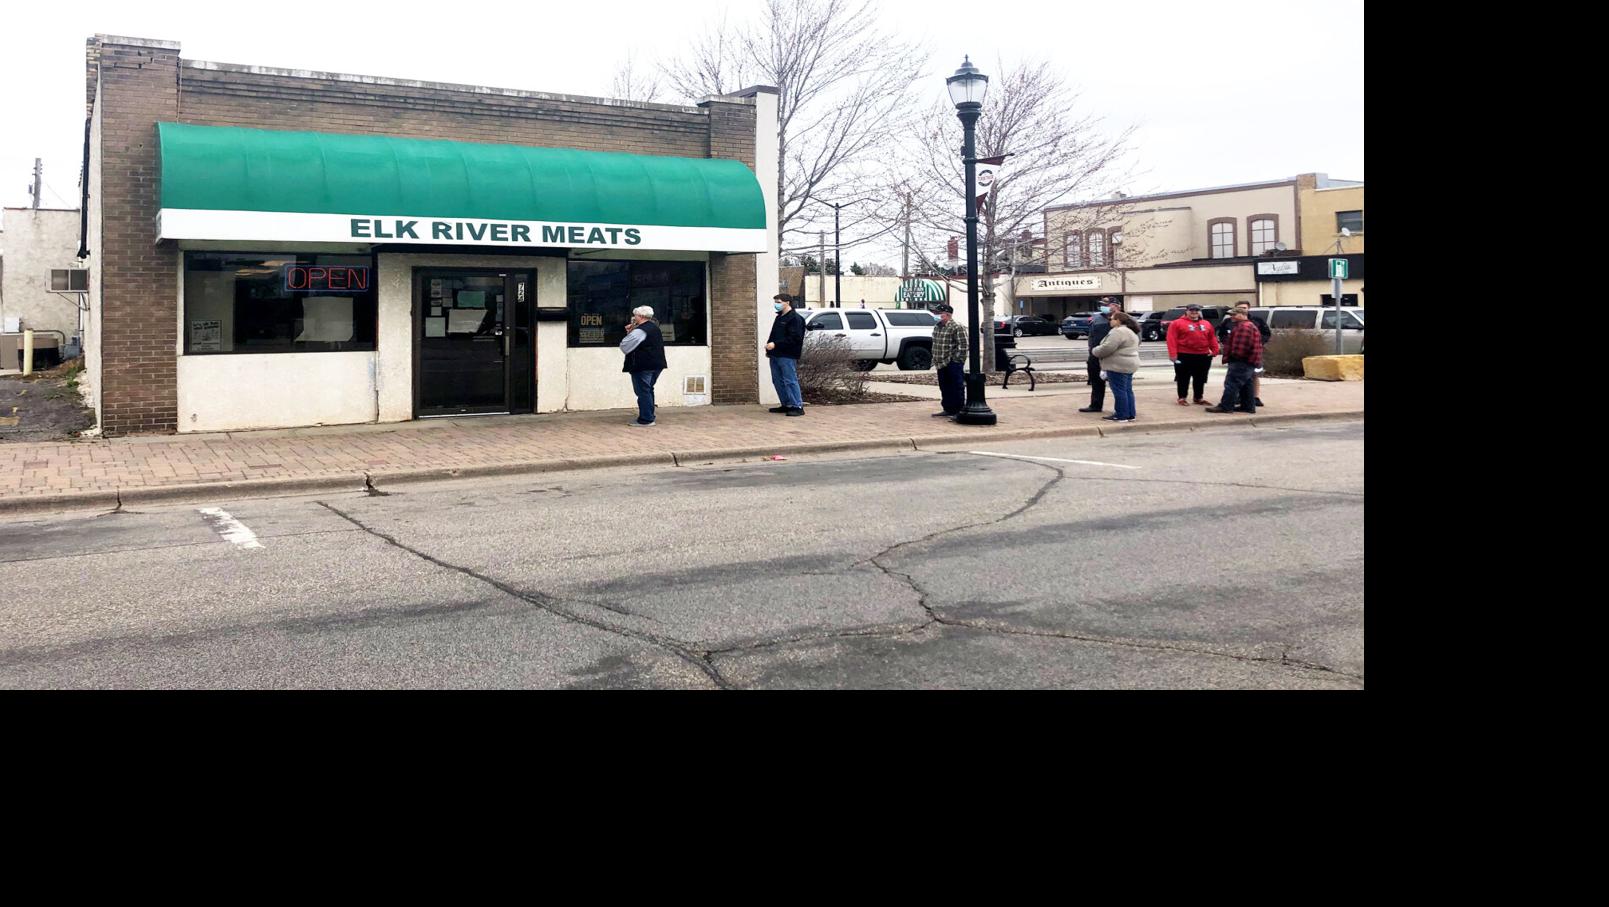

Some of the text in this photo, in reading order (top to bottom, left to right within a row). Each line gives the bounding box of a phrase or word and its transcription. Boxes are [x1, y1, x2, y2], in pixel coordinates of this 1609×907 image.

[350, 218, 642, 246] ELK RIVER MEATS
[288, 267, 366, 289] OPEN
[1037, 279, 1093, 288] Antiques
[580, 315, 603, 326] OPEN
